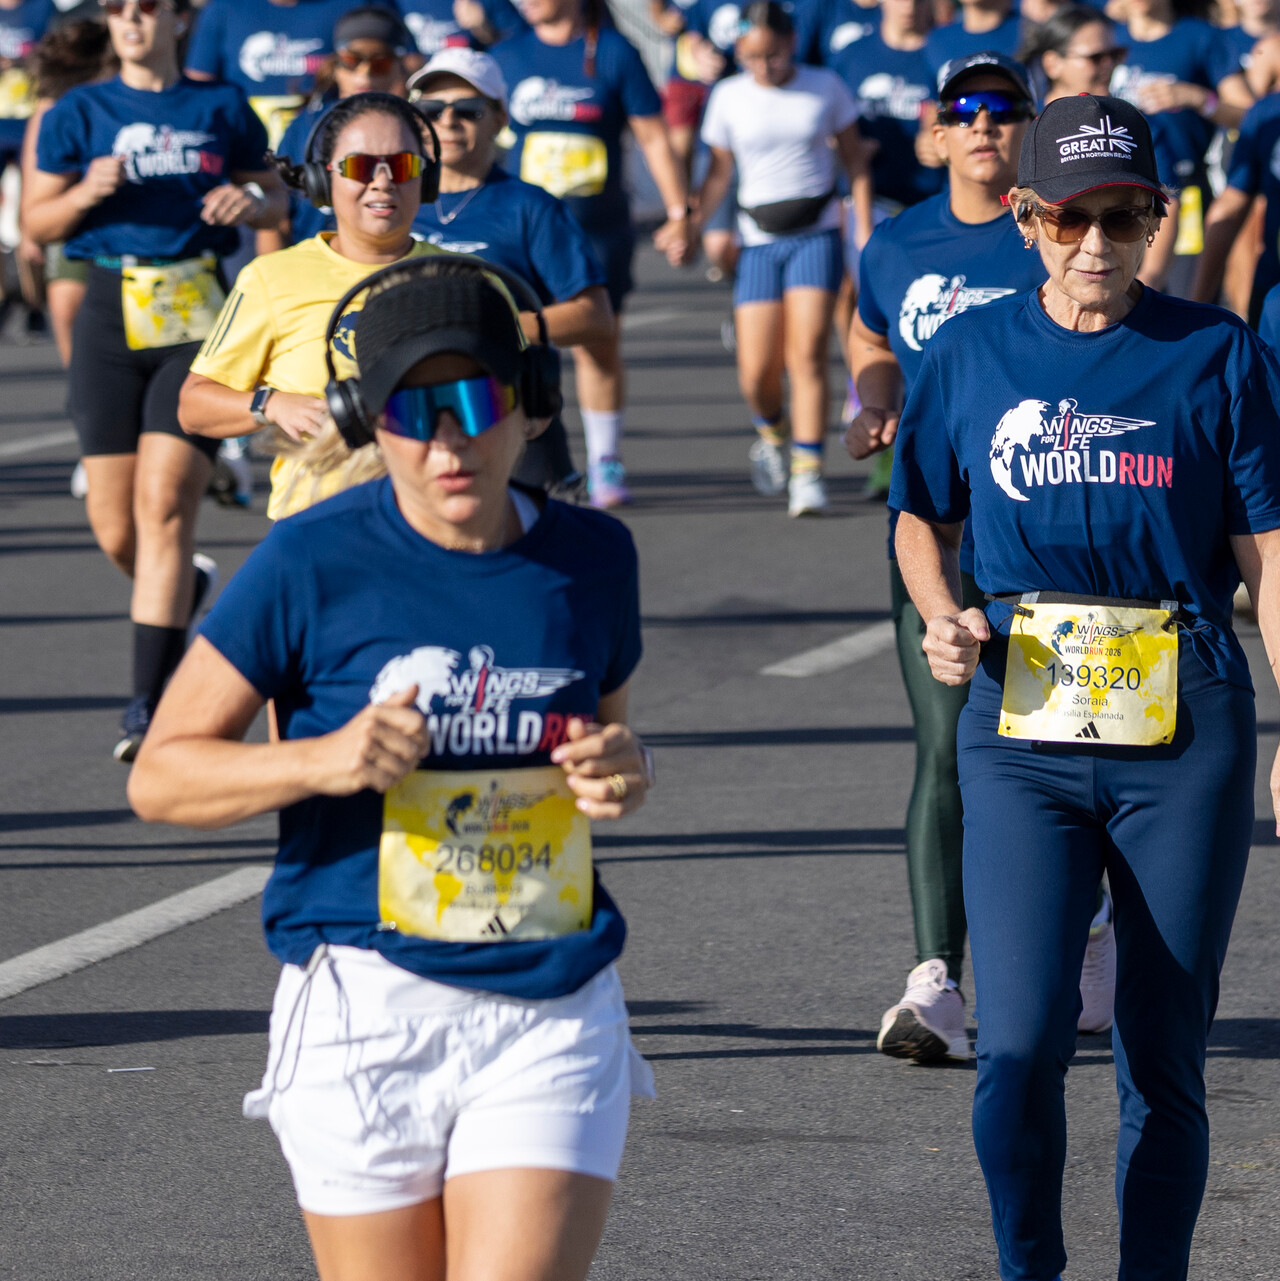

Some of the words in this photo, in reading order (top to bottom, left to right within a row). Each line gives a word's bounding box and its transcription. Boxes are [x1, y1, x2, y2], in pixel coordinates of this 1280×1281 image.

[1059, 138, 1107, 156] GREAT
[938, 287, 985, 304] WINGS
[1042, 413, 1113, 435] WINGS
[1040, 435, 1056, 444] FOR
[1053, 433, 1094, 451] LIFE
[1020, 450, 1174, 488] WORLDRUN
[1076, 622, 1119, 637] WINGS
[1081, 633, 1107, 646] LIFE
[1104, 647, 1122, 657] 2026
[450, 666, 540, 694] WINGS
[1047, 662, 1141, 691] 139320
[461, 693, 512, 715] LIFE
[1072, 694, 1109, 707] Soraia
[436, 841, 552, 875] 268034
